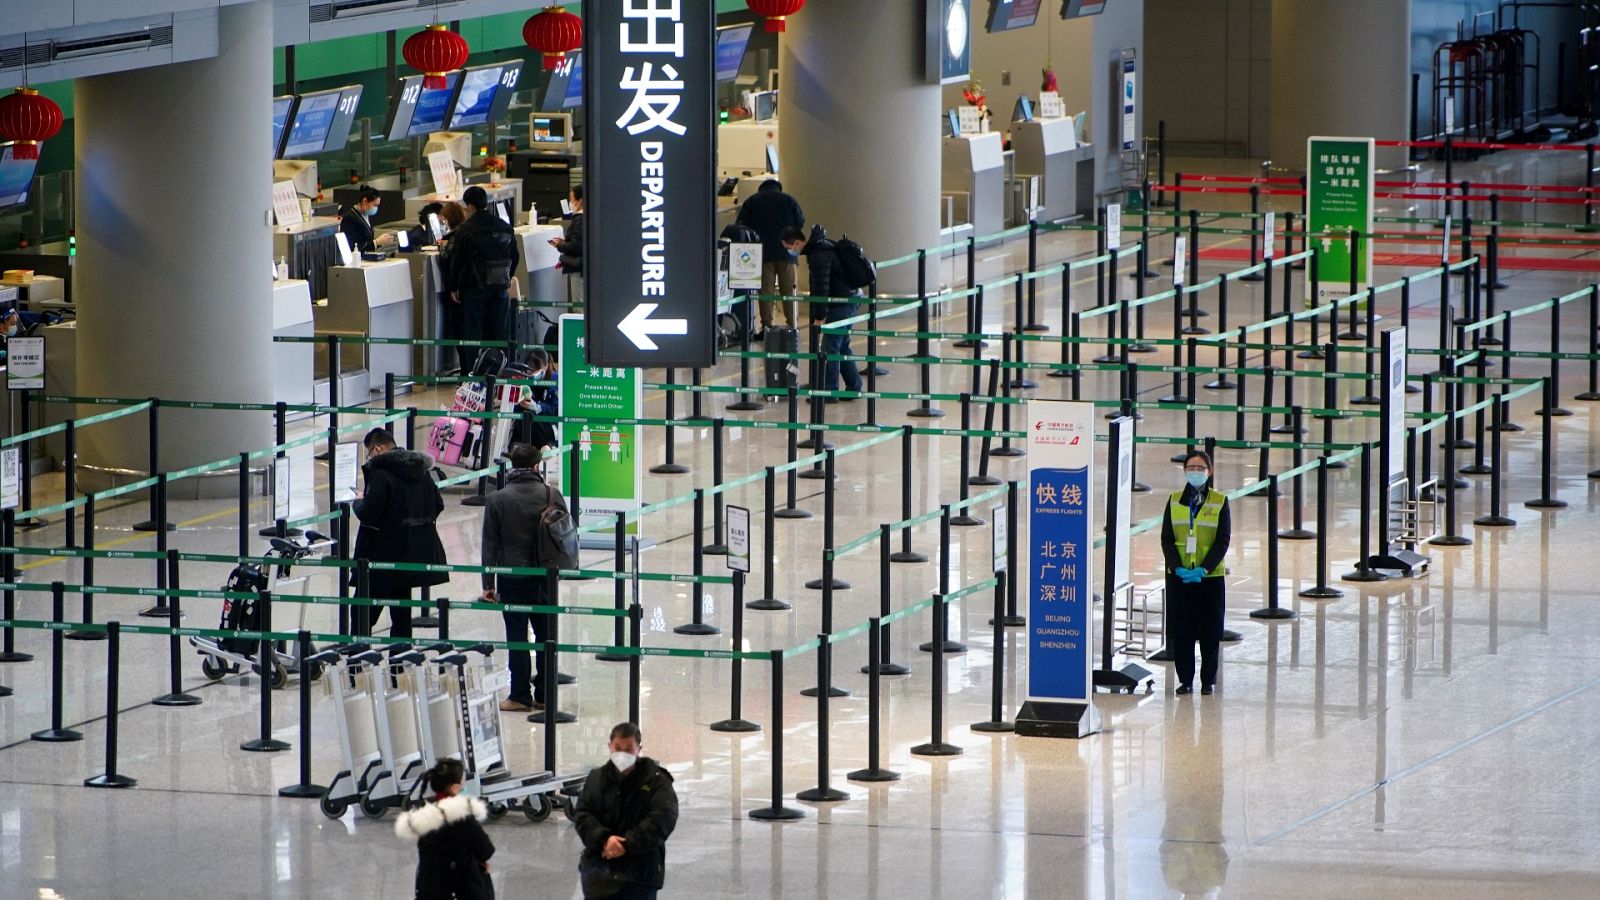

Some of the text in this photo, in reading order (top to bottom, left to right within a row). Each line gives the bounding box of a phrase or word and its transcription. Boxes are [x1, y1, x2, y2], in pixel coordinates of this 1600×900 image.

[615, 0, 688, 136] 出发
[502, 68, 519, 88] D13
[402, 84, 420, 104] D12
[340, 95, 358, 115] D11
[1320, 154, 1361, 165] 排队等候
[1325, 166, 1355, 177] 请保持
[1319, 178, 1361, 189] 一米距离
[640, 141, 665, 296] DEPARTURE
[576, 366, 626, 379] 一米距离
[608, 394, 623, 402] Away
[1036, 482, 1083, 506] 快线
[1040, 541, 1077, 559] 北京
[1040, 563, 1077, 581] 广州
[1040, 585, 1077, 603] 深圳
[1045, 615, 1071, 623] BEIJING
[1036, 627, 1080, 636] GUANGZHOU
[1040, 641, 1076, 649] SHENZHEN
